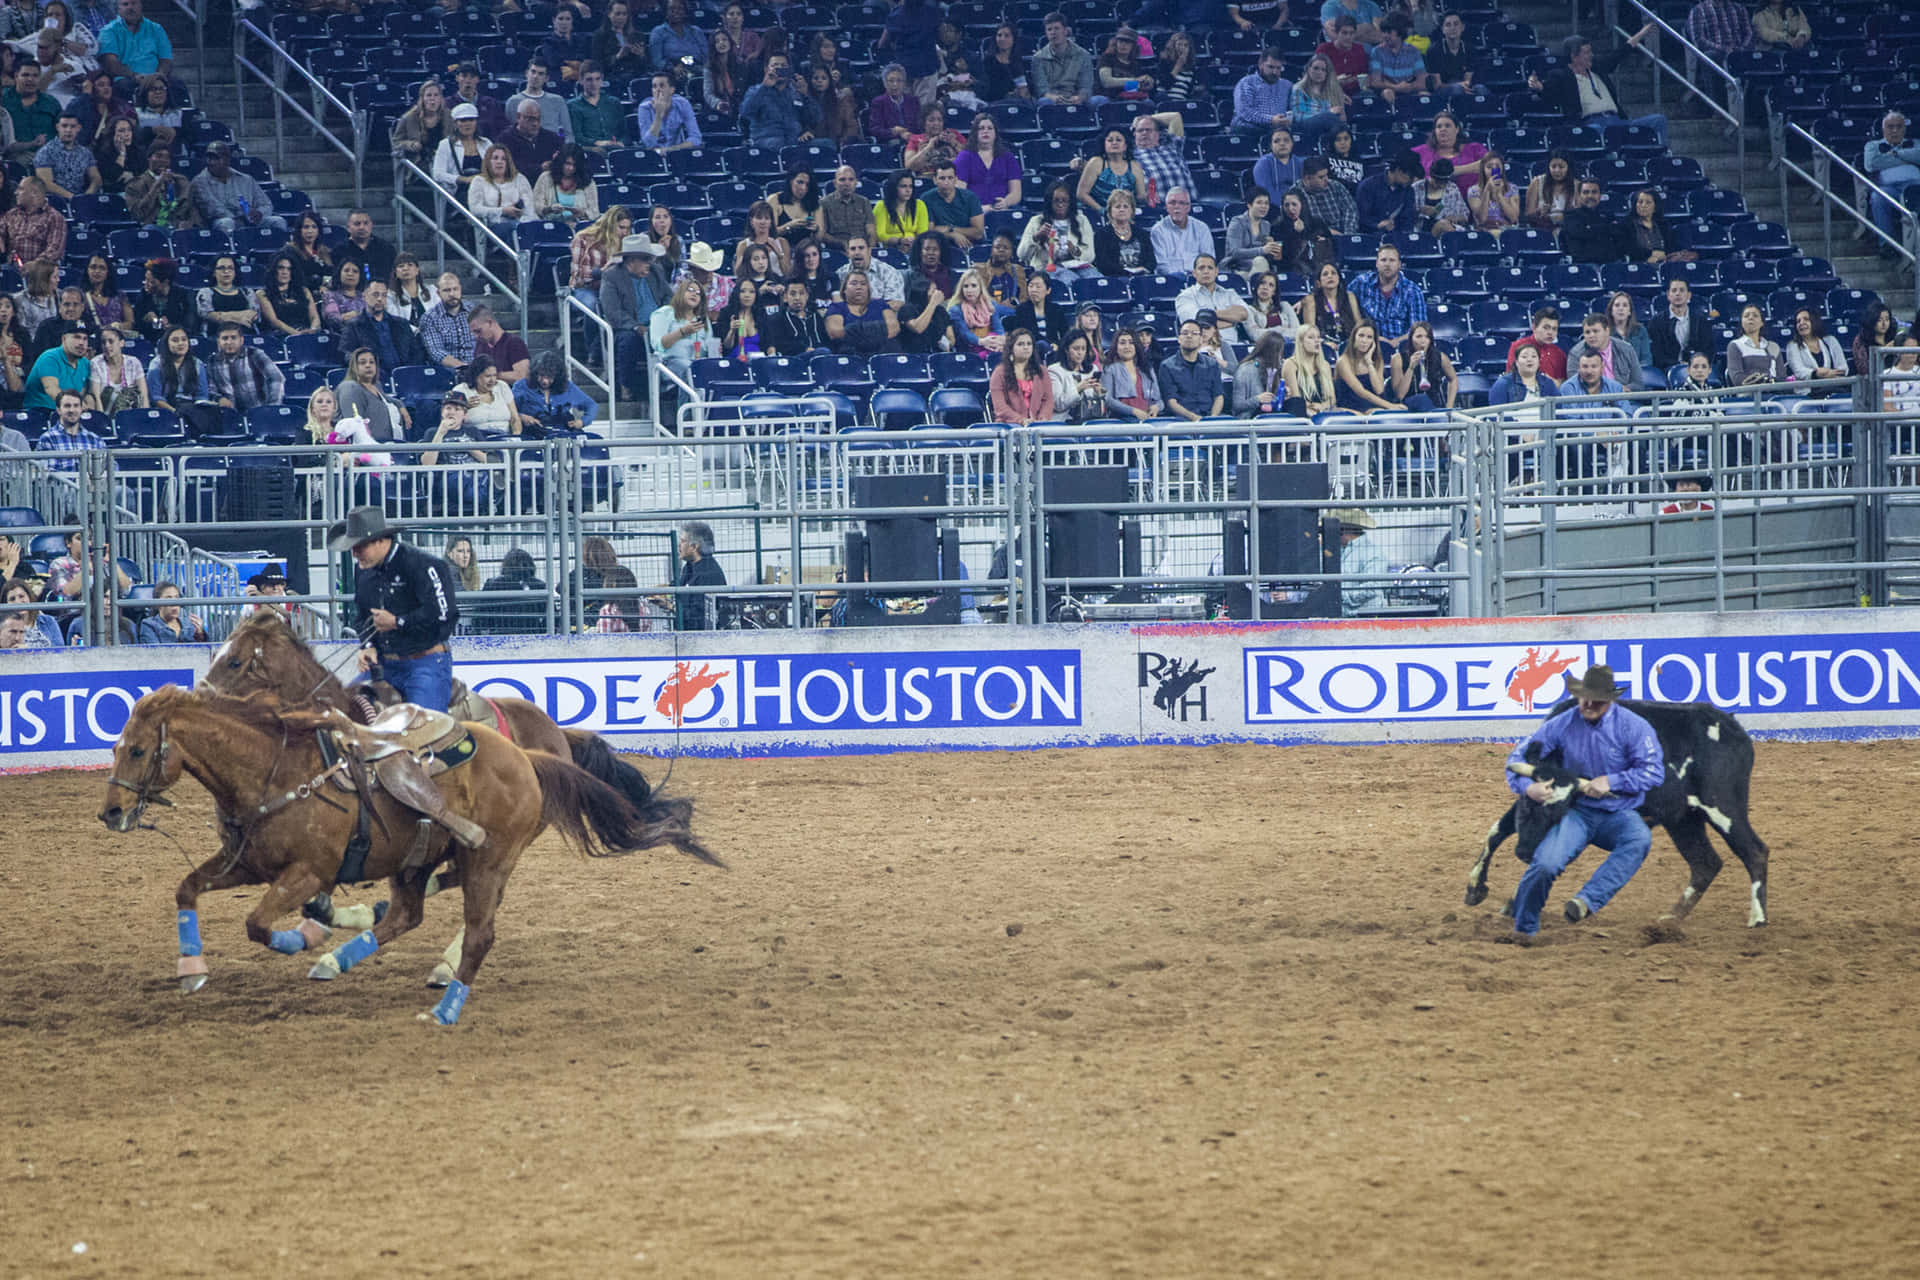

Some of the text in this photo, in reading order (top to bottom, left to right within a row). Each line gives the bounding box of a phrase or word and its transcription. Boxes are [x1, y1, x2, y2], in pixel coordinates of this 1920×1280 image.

[472, 659, 1076, 726] DEO HOUSTON
[1592, 644, 1920, 707] HOUSTON
[0, 685, 189, 747] STO
